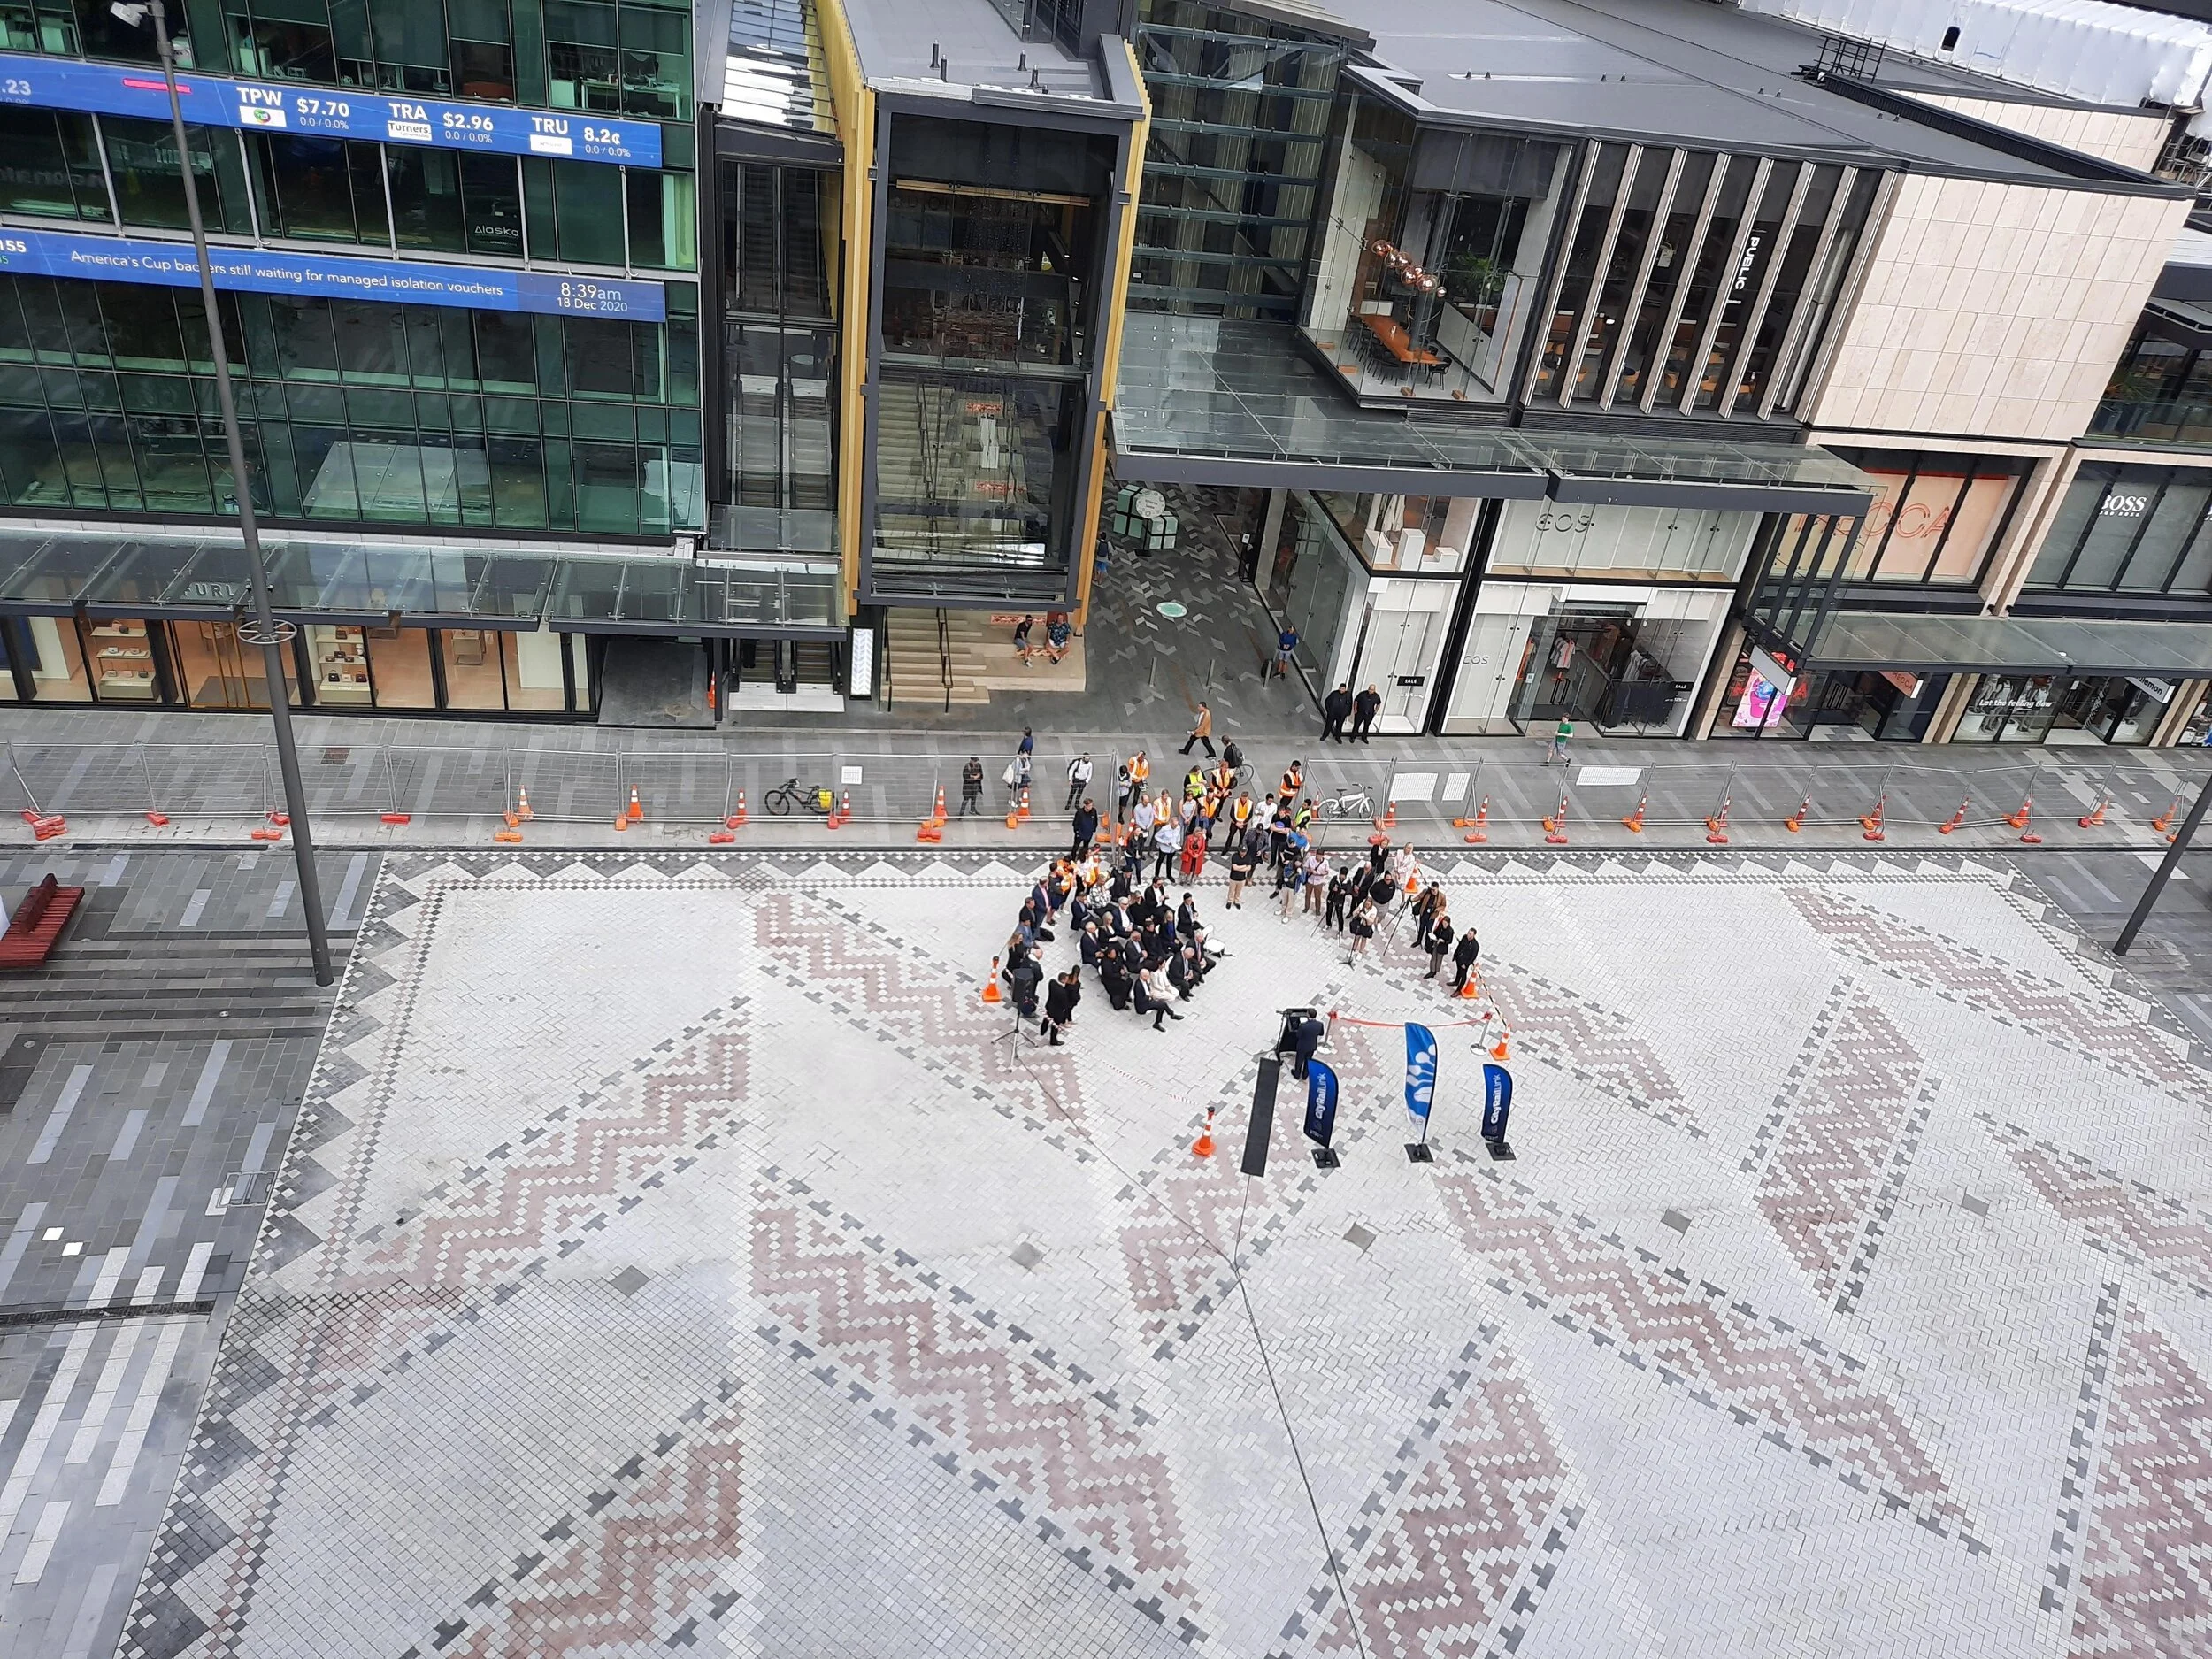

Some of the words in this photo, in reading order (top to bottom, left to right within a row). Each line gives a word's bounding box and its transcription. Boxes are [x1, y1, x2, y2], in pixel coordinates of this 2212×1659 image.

[236, 87, 282, 107] TPW
[296, 96, 350, 118] $7.70
[388, 103, 429, 121] TRA
[299, 117, 317, 127] 0.0
[325, 119, 349, 130] 0.0%
[388, 122, 429, 134] Turners
[442, 112, 494, 132] $2.96
[531, 117, 569, 134] TRU
[445, 130, 460, 141] 0.0
[469, 133, 493, 144] 0.0%
[585, 144, 600, 155] 0.0
[608, 147, 632, 158] 0.0%
[1734, 236, 1761, 290] PUBLIC
[71, 250, 139, 267] America's
[142, 257, 172, 273] Cup
[175, 258, 227, 275] bacers
[229, 265, 252, 276] still
[255, 266, 302, 282] waiting
[305, 268, 323, 281] for
[327, 273, 388, 288] managed
[391, 276, 444, 292] isolation
[447, 282, 503, 296] vouchers
[560, 281, 622, 301] 8:39am
[557, 296, 571, 308] 18
[574, 298, 597, 310] Dec
[600, 300, 628, 312] 2020
[1535, 513, 1591, 533] COS
[1463, 656, 1489, 665] COS
[2136, 676, 2163, 696] ulemon
